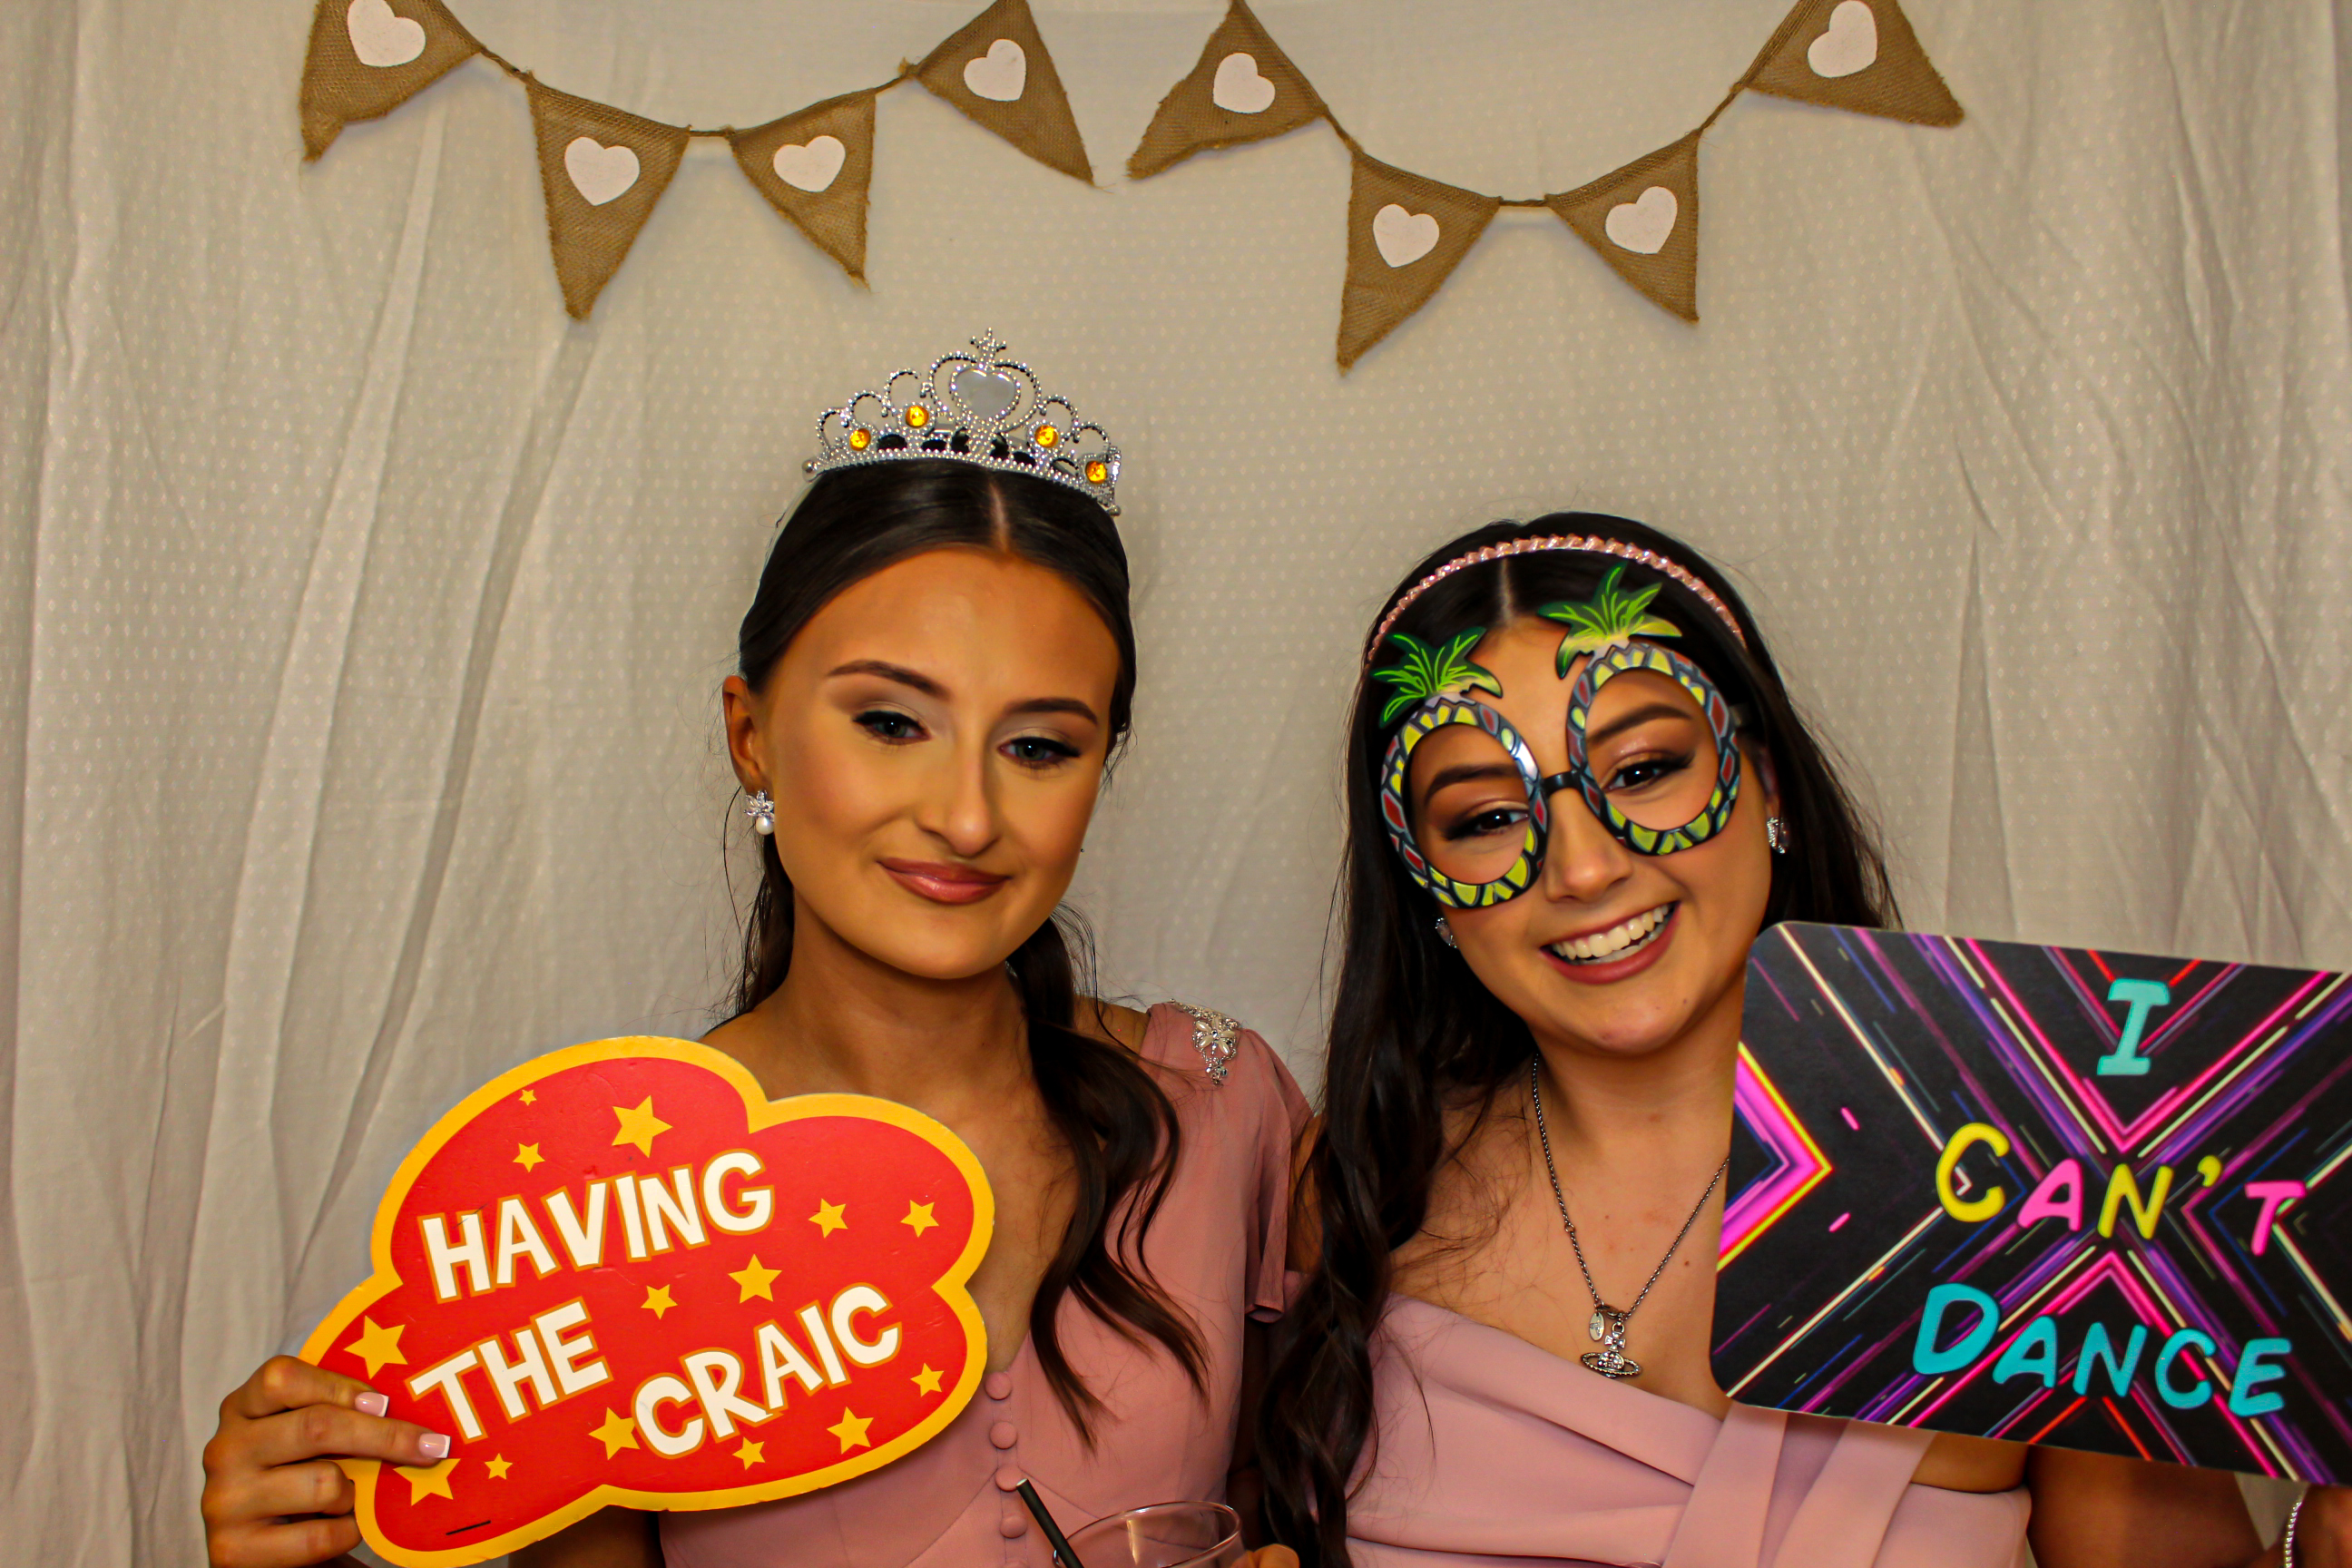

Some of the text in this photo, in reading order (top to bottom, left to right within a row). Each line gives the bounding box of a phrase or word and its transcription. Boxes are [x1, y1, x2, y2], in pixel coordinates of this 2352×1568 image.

[2096, 977, 2171, 1075] I
[420, 1150, 773, 1301] HAVING
[1936, 1122, 2308, 1257] CAN'T
[409, 1300, 609, 1440] THE
[634, 1285, 899, 1455] CRAIC
[1912, 1282, 2292, 1417] DANCE
